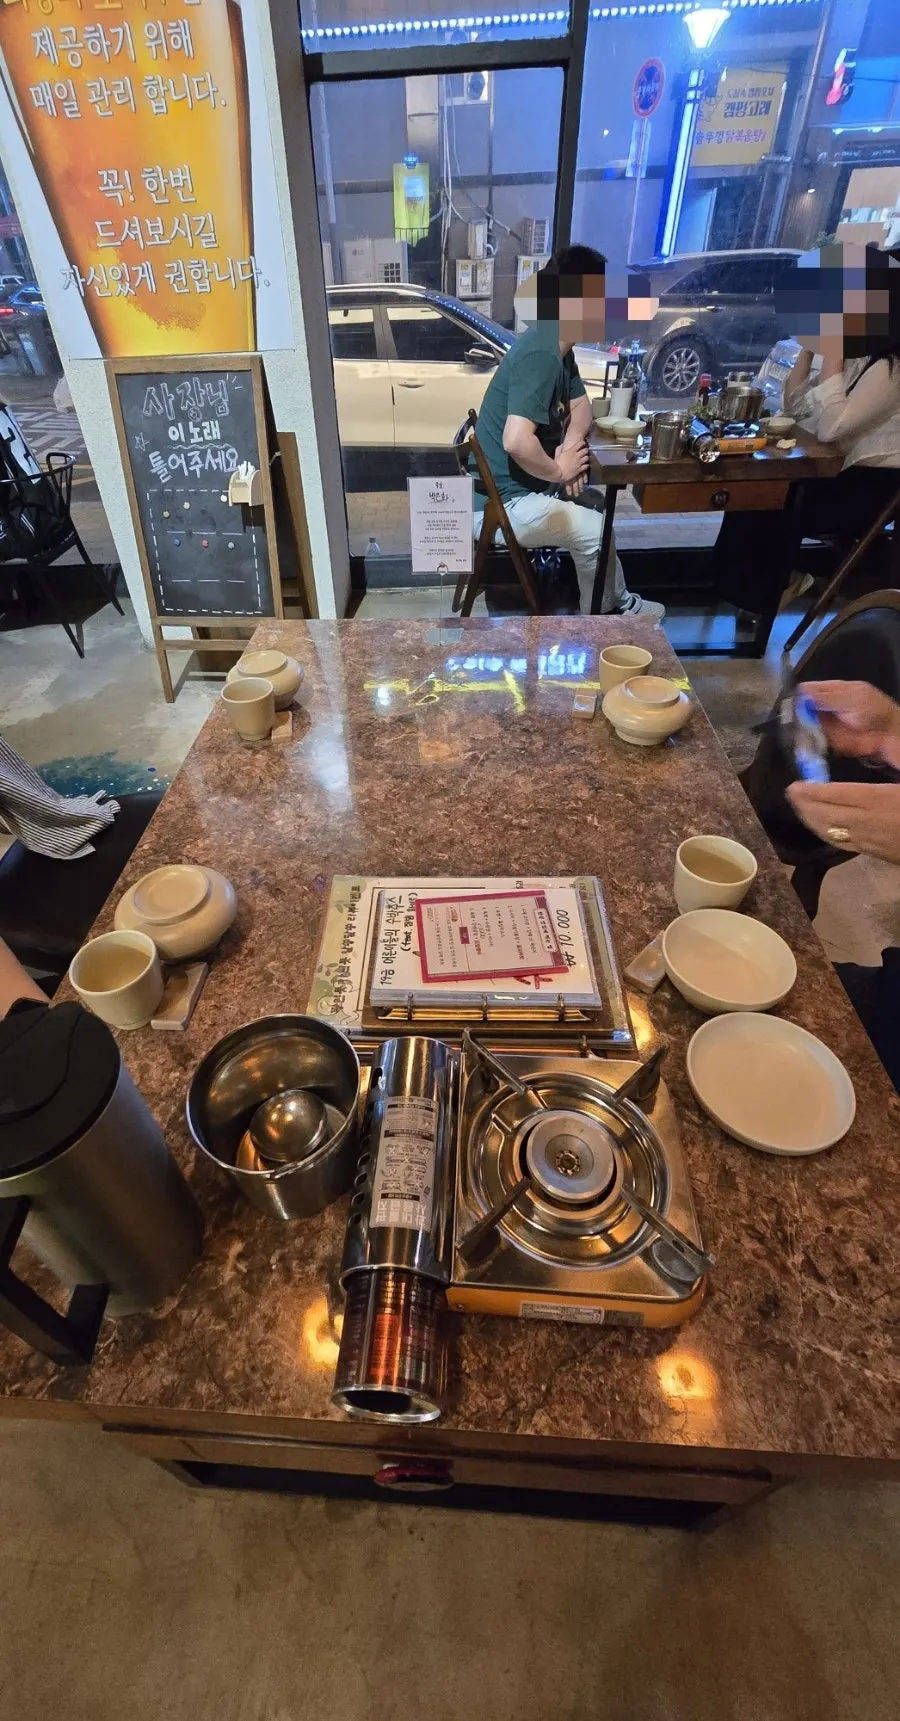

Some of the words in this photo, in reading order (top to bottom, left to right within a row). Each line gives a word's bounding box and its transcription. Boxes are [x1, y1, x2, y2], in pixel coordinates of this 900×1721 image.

[31, 19, 136, 68] 제공하기
[143, 18, 195, 60] 위해
[29, 79, 82, 119] 매일
[85, 76, 136, 117] 관리
[142, 71, 227, 115] 합니다.
[724, 100, 772, 118] 캠핑고래
[97, 169, 135, 207] 꼭!
[141, 164, 196, 205] 한번
[94, 213, 219, 250] 드셔보시길
[60, 260, 156, 298] 자신있게
[164, 256, 271, 295] 권합니다.
[142, 377, 229, 421] 사장님
[168, 422, 185, 443] 이
[188, 419, 221, 444] 노래
[148, 447, 239, 483] 틀어주세요
[380, 969, 395, 985] 19금
